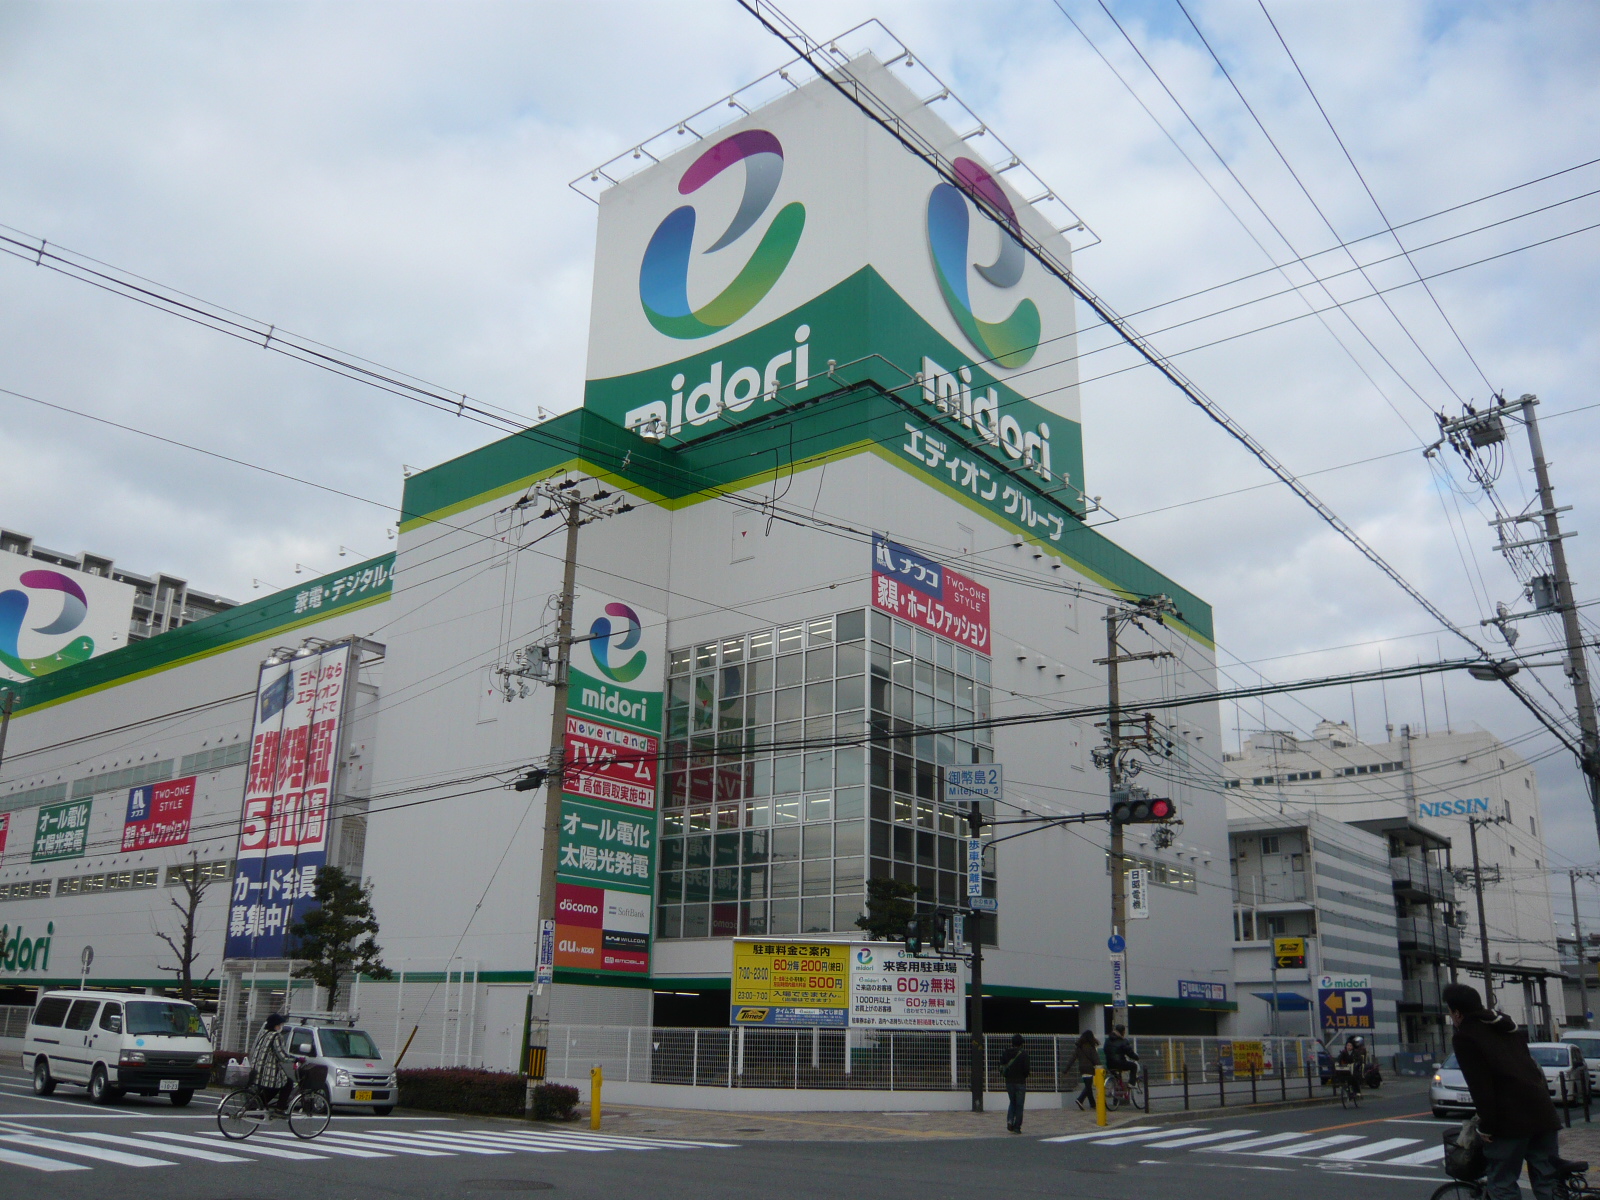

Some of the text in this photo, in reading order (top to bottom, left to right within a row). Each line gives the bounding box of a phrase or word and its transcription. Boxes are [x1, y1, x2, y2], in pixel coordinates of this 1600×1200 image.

[625, 324, 810, 439] midori
[922, 356, 1051, 482] midori
[904, 422, 1064, 540] エディオン グループ
[900, 559, 938, 588] ナフコ
[946, 575, 986, 602] TWO-ONE
[877, 575, 986, 646] 家具・ホームファッション
[954, 592, 980, 612] STYLE
[299, 662, 342, 686] ミドリなら
[296, 683, 340, 704] エディオン
[581, 686, 647, 721] midori
[306, 700, 337, 718] カードで
[568, 720, 647, 751] NeverLand
[570, 740, 651, 781] TVゲーム
[155, 785, 190, 800] TWO-ONE
[159, 799, 183, 811] STYLE
[1419, 797, 1489, 818] NISSIN
[39, 806, 87, 832] オール電化
[563, 812, 650, 848] オール電化
[35, 829, 84, 855] 太陽光発電
[561, 843, 648, 878] 太陽光発電
[969, 840, 980, 895] 歩車分離式
[234, 865, 317, 901] カード会員
[560, 899, 598, 914] docomo
[618, 907, 645, 918] SoftBank
[559, 940, 576, 952] au
[753, 944, 830, 956] 駐車料金ご案内
[883, 961, 957, 973] 来客用駐車場
[809, 976, 843, 988] 500円
[1334, 978, 1367, 988] midori
[1344, 991, 1367, 1014] P
[740, 1010, 766, 1020] Times
[1326, 1016, 1369, 1027] 入口専用
